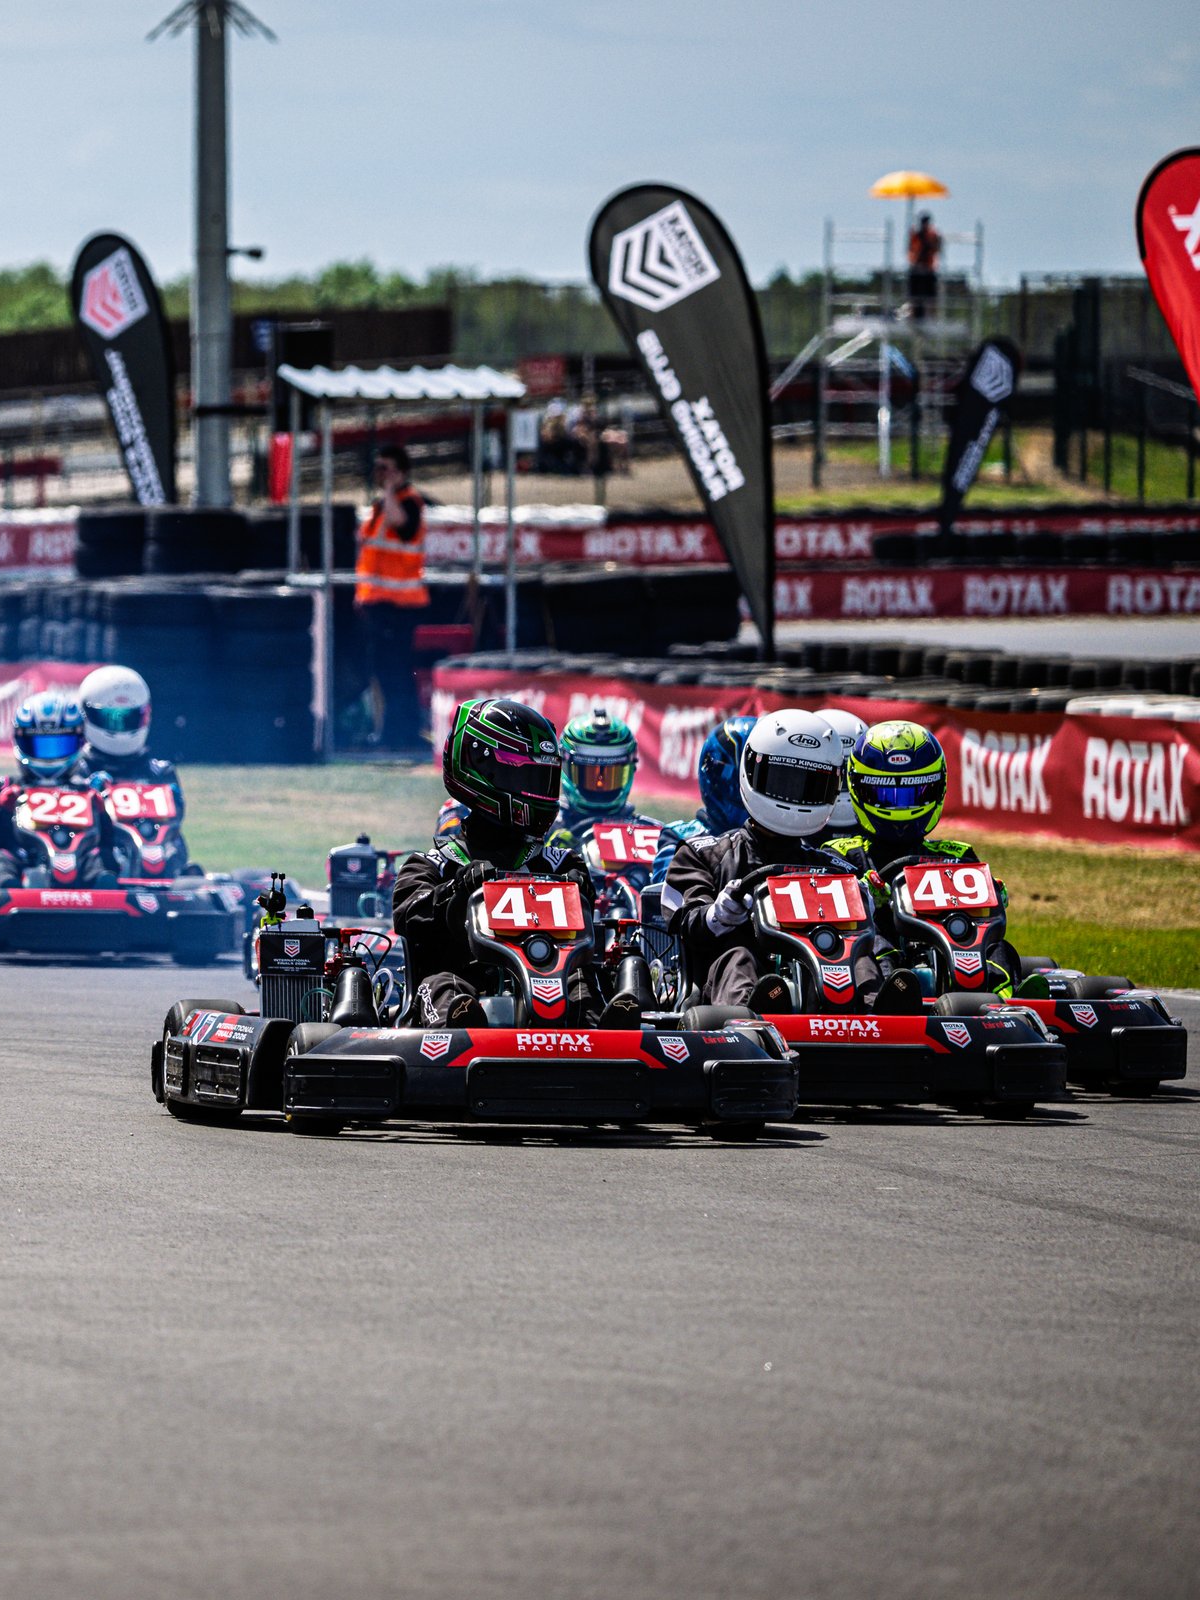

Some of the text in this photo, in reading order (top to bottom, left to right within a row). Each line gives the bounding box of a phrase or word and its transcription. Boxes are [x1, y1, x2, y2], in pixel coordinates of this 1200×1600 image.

[691, 396, 746, 491] ROTAX
[583, 526, 706, 559] ROTAX
[776, 524, 872, 557] OTAX
[842, 576, 935, 614] ROTAX
[963, 574, 1069, 614] ROTAX
[1106, 574, 1200, 614] ROTA
[768, 755, 833, 771] UNITED KINGDOM
[861, 773, 942, 785] JOSHUA ROBINSON
[961, 729, 1052, 814] ROTAX
[1083, 737, 1191, 825] ROTAX
[28, 792, 89, 825] 22
[111, 787, 174, 818] 91
[599, 828, 660, 861] 15
[941, 844, 963, 853] OMP
[775, 880, 850, 919] 11
[913, 868, 989, 907] 49
[491, 887, 569, 927] 41
[215, 1029, 233, 1038] FINALS
[216, 1022, 255, 1034] INTERNATIONAL
[516, 1034, 591, 1046] ROTAX
[809, 1019, 880, 1031] ROTAX
[810, 1030, 881, 1038] RACING
